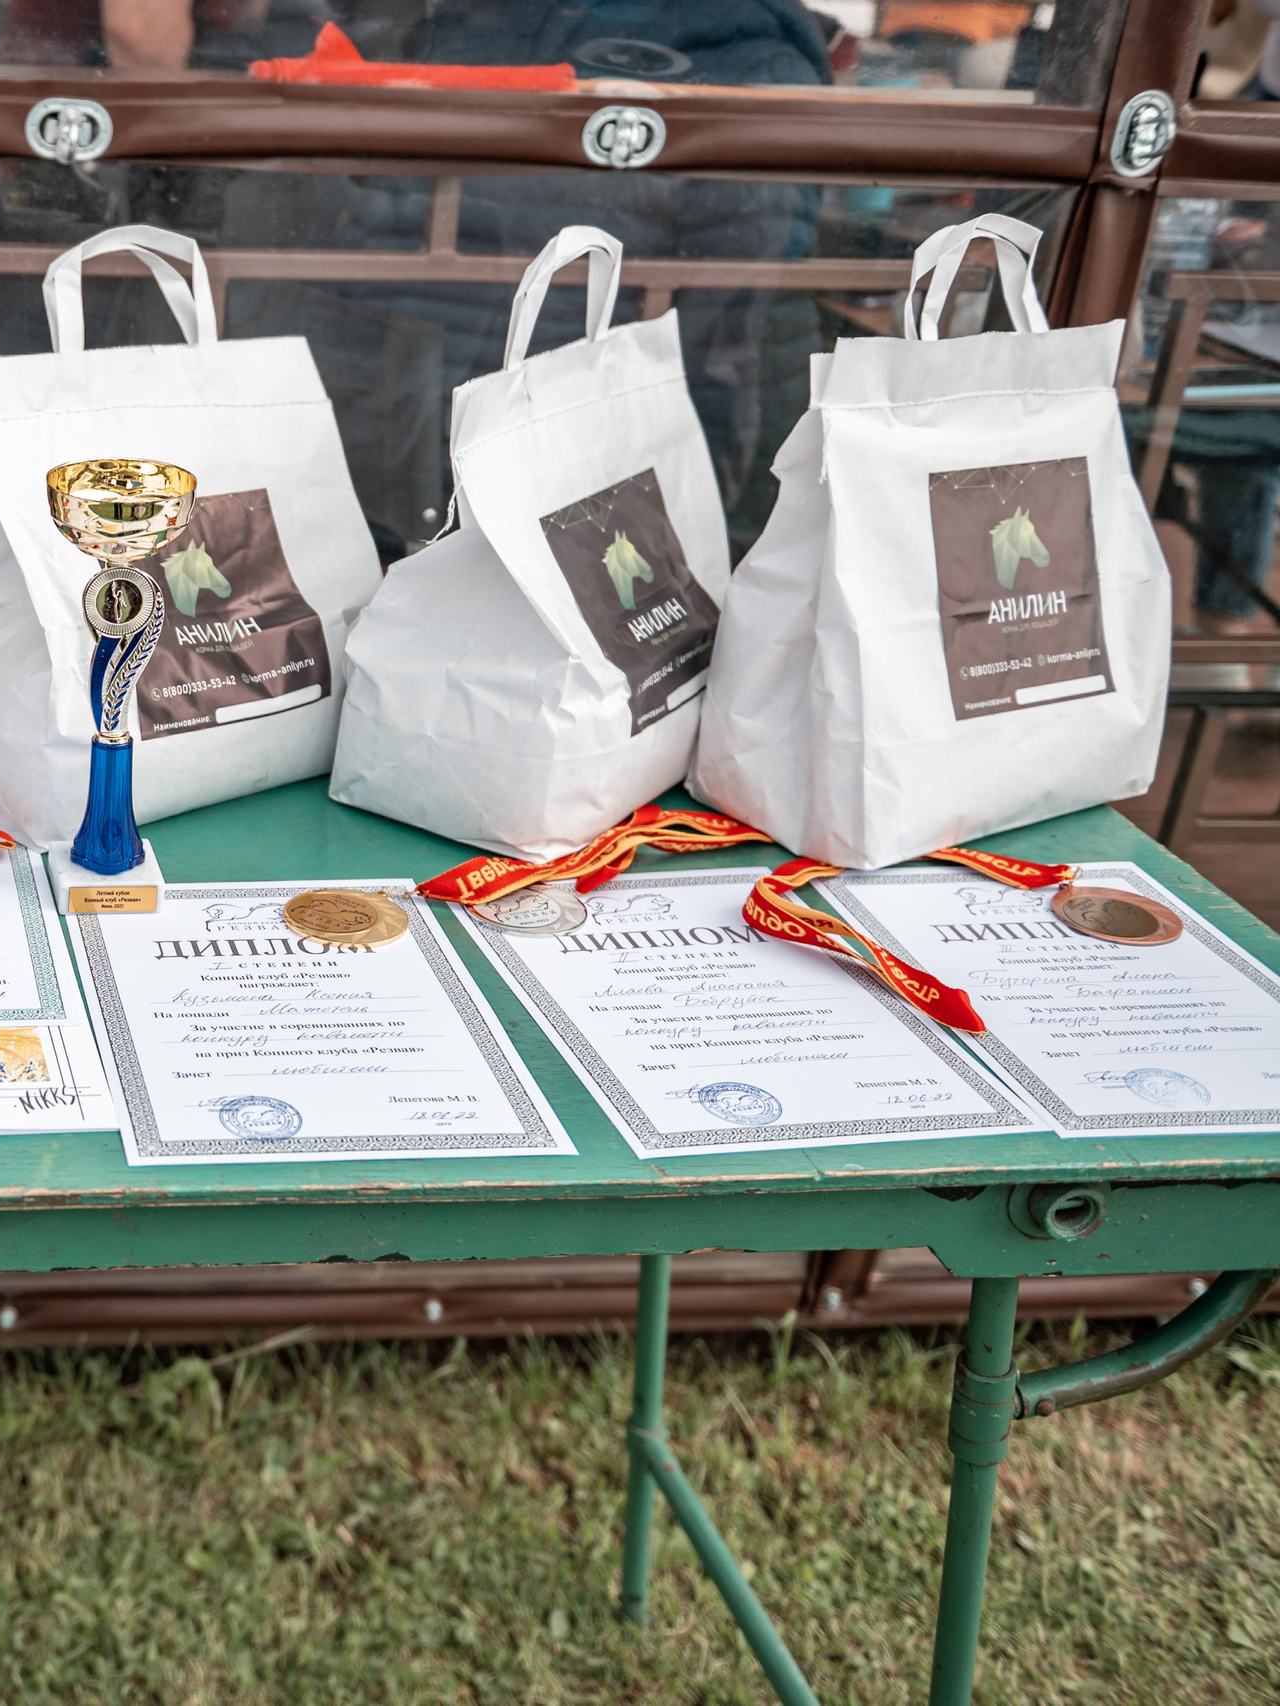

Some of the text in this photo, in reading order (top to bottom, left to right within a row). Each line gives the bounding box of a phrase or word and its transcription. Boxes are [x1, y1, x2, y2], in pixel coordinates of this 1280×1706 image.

[987, 590, 1067, 624] АНИЛИН
[628, 598, 687, 642] АНИЛИН
[175, 617, 262, 646] АНИЛИН
[970, 648, 1100, 677] 8(800)333-53-42 korma-anilyn.ru
[163, 675, 237, 698] 8(800)333-53-42
[154, 714, 212, 732] Наименование:
[605, 915, 678, 924] РЕЗВАЯ
[930, 920, 1074, 943] ДИПЛ
[644, 951, 738, 961] СТЕПЕНИ
[997, 957, 1050, 965] Конный
[1052, 956, 1082, 964] клуб
[613, 966, 666, 975] Конный
[668, 964, 698, 973] клуб
[1040, 964, 1117, 972] награждает:
[258, 973, 289, 981] клуб
[655, 973, 732, 981] награждает:
[1044, 1006, 1097, 1014] участие
[1109, 1002, 1207, 1012] соревнованиях
[650, 1016, 702, 1025] участие
[716, 1010, 814, 1021] соревнованиях
[280, 1022, 384, 1030] соревнованиях
[1162, 1027, 1203, 1036] клуба
[764, 1036, 804, 1045] клуба
[317, 1047, 358, 1056] клуба
